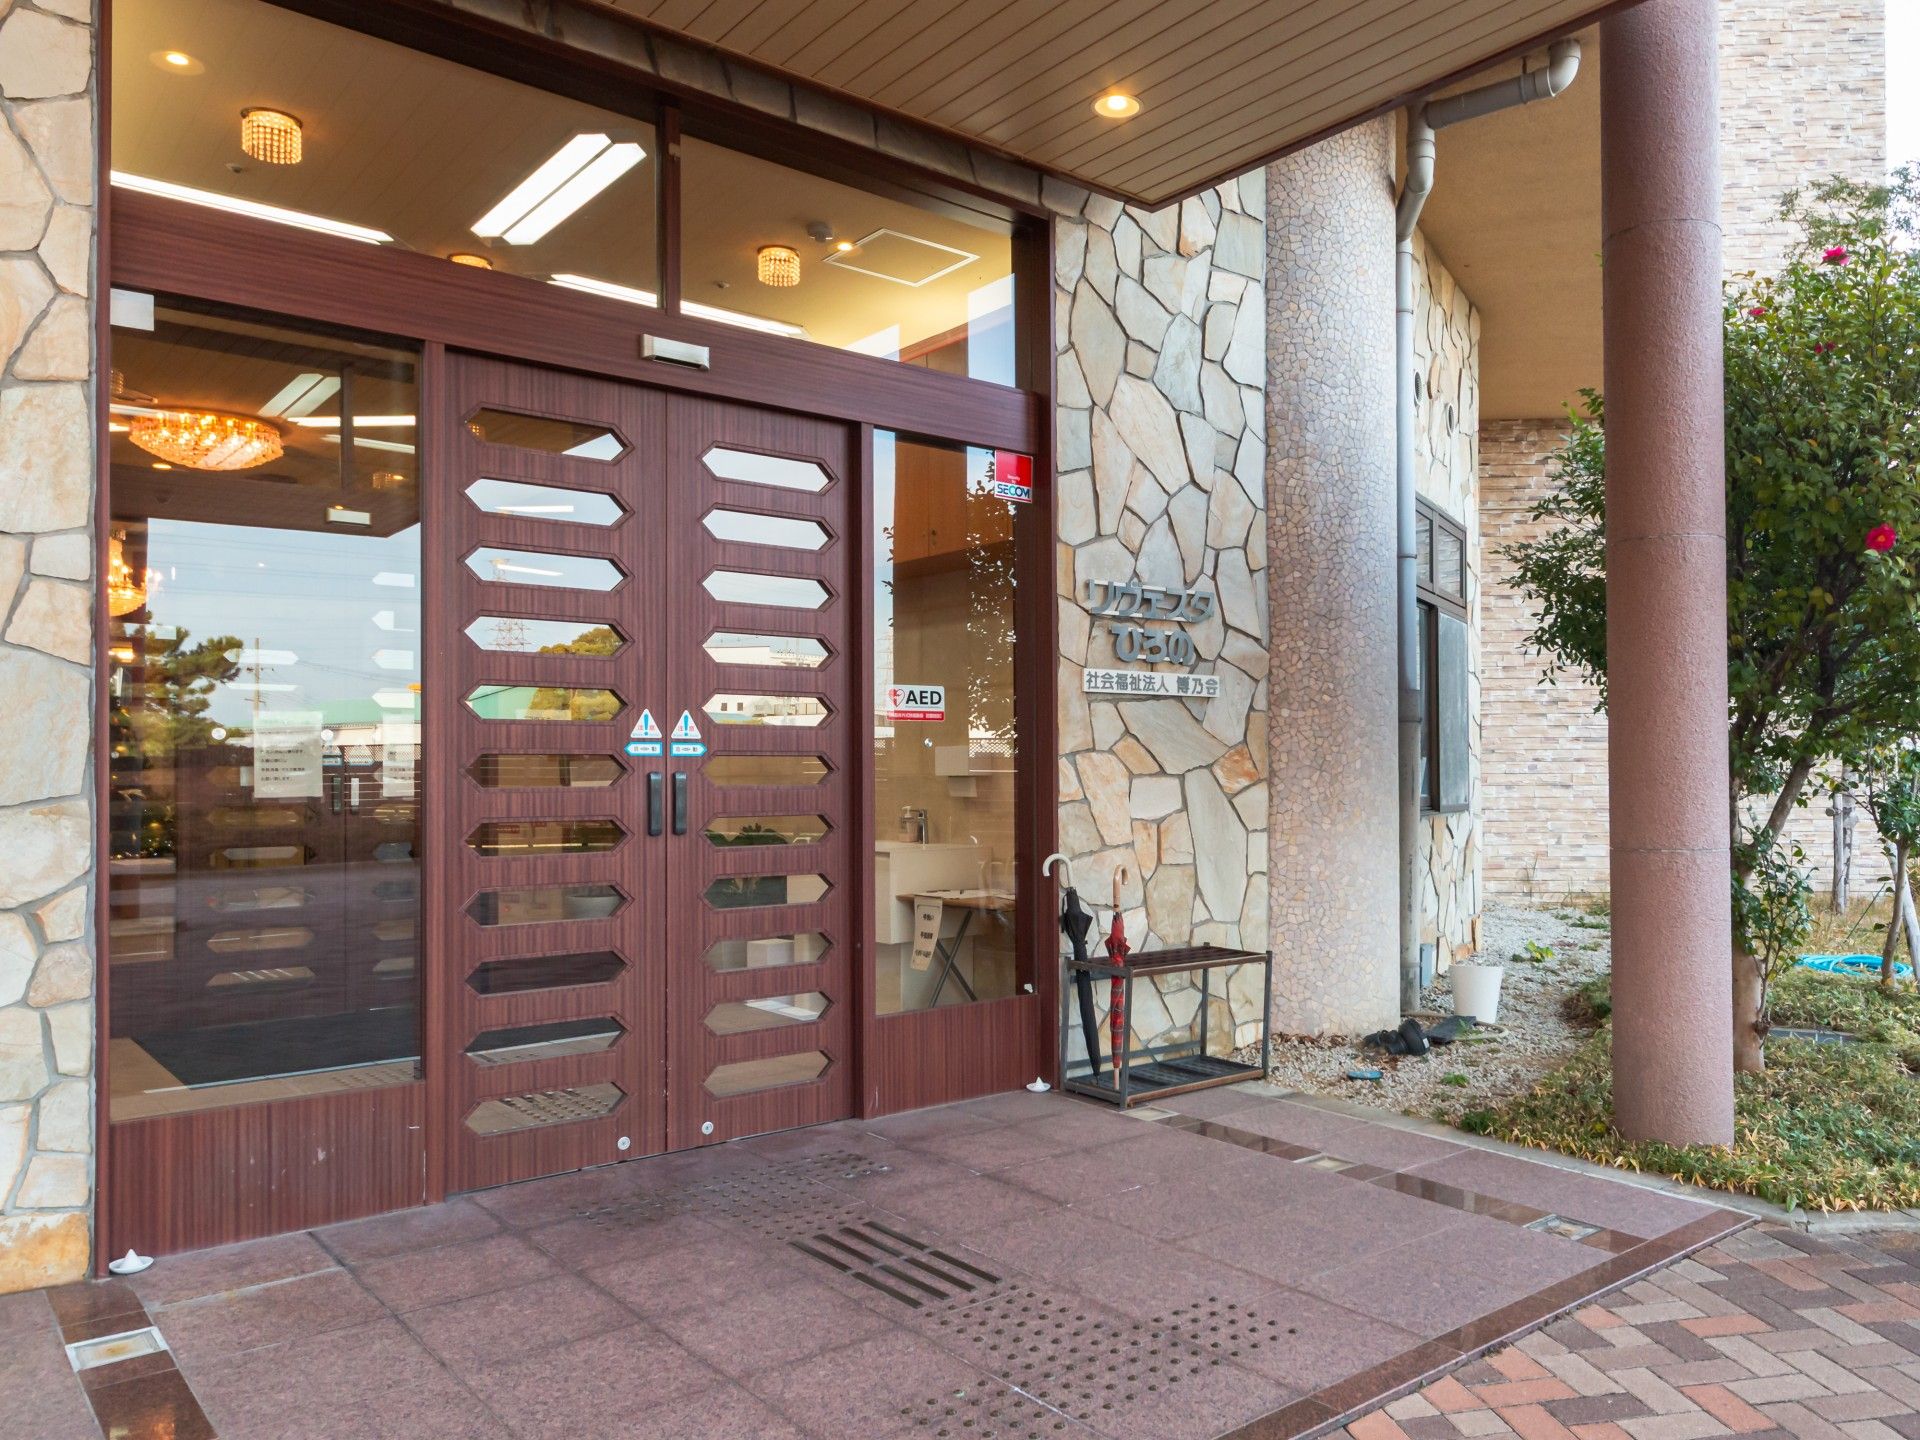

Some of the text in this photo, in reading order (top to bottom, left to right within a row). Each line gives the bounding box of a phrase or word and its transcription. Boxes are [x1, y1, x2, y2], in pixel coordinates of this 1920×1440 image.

[997, 483, 1030, 498] SECOM
[1111, 622, 1196, 665] ひろの
[1086, 671, 1169, 693] 社会福祉法人
[905, 690, 942, 705] AED
